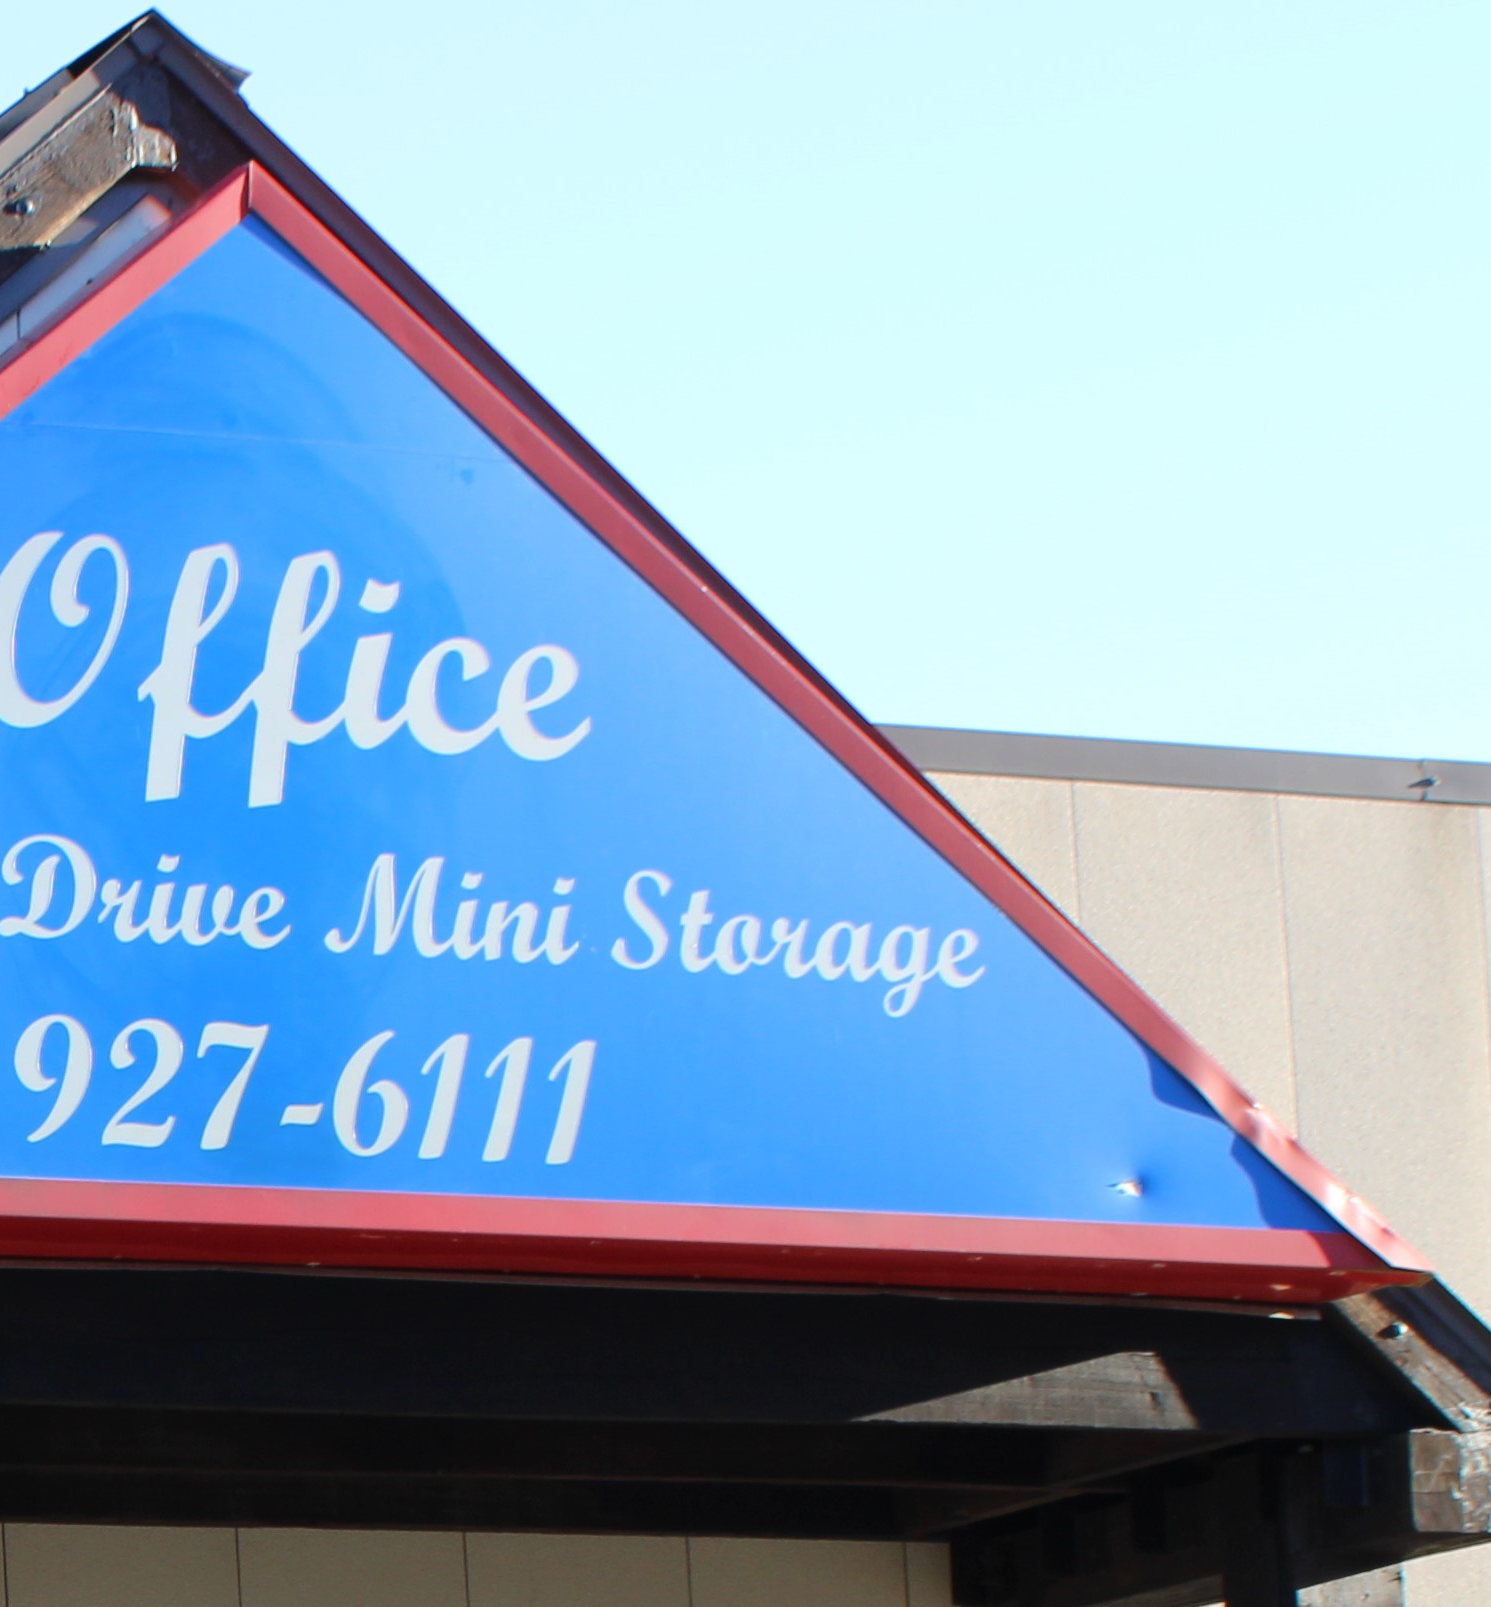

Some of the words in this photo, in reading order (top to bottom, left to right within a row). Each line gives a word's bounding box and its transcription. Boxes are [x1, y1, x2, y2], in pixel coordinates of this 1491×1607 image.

[325, 852, 579, 966] Mini
[610, 868, 987, 1018] Storage
[14, 1013, 597, 1165] 927-6111
